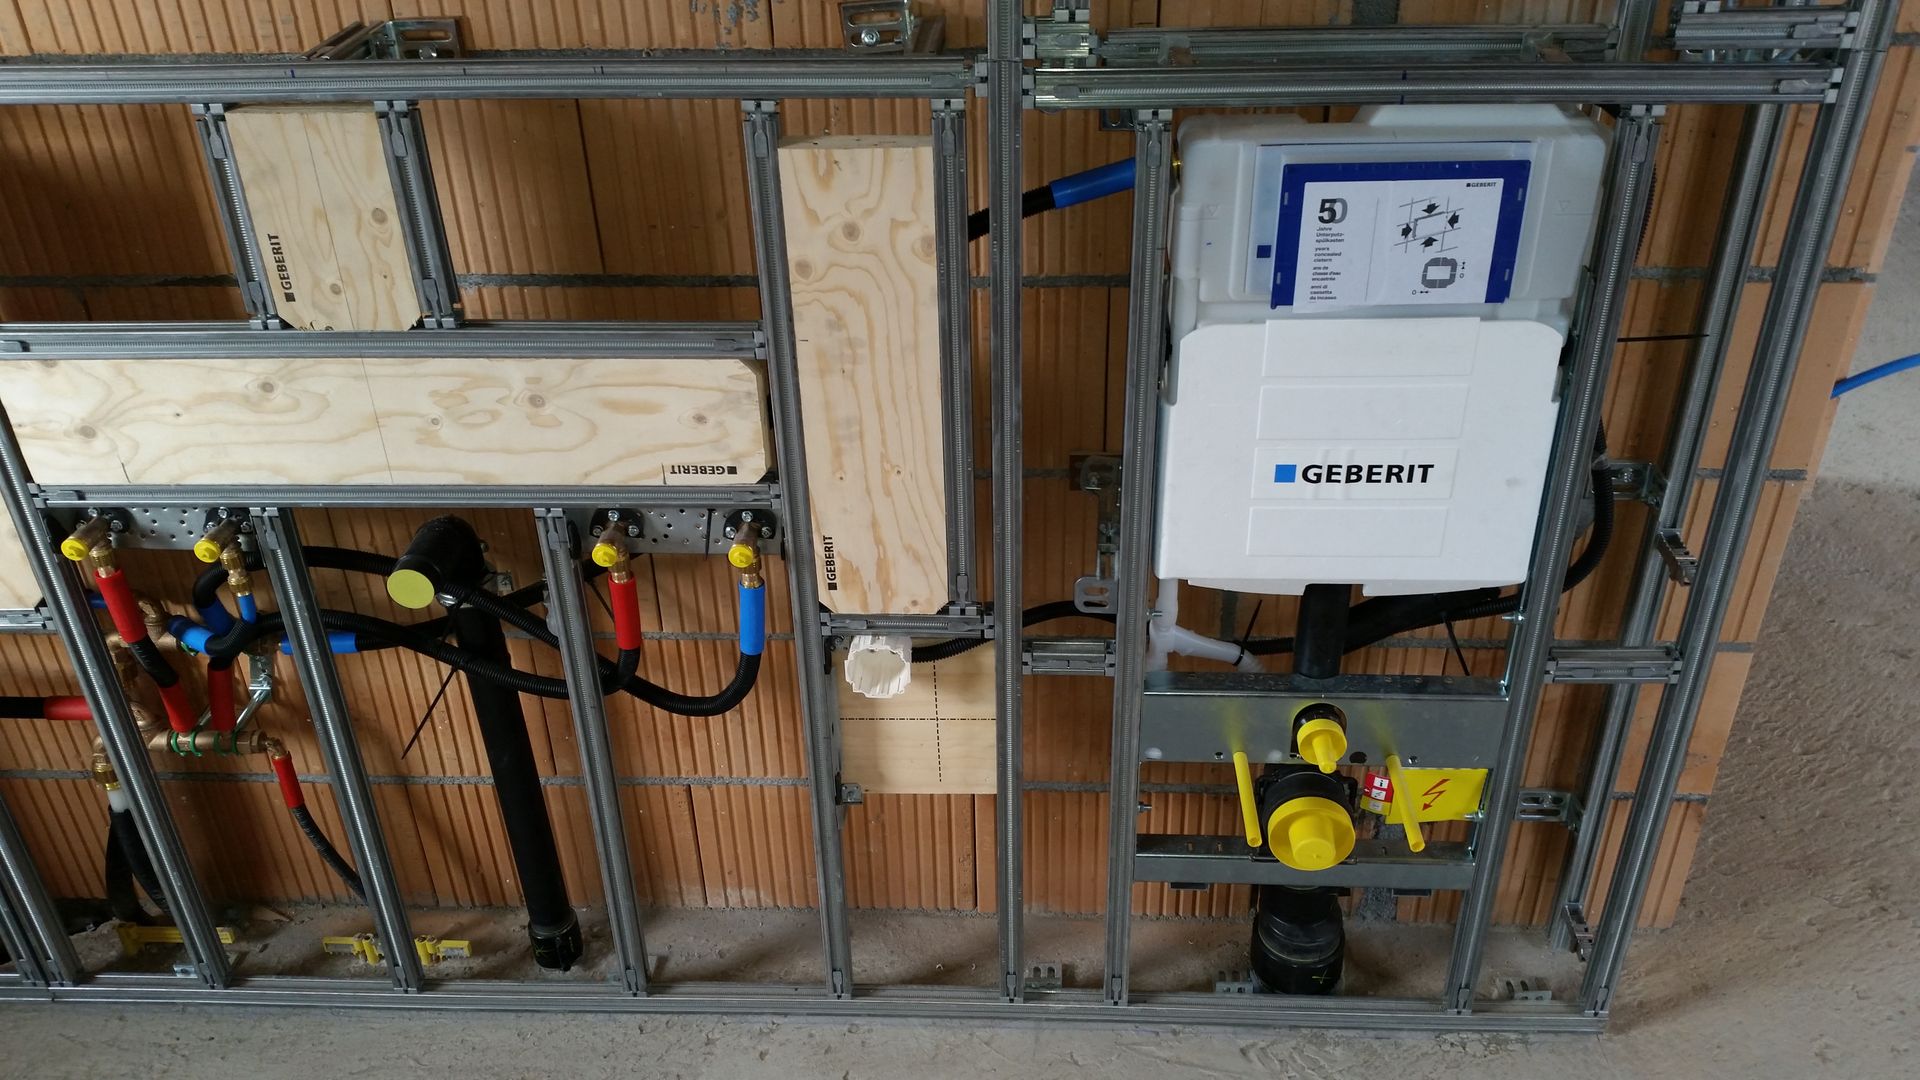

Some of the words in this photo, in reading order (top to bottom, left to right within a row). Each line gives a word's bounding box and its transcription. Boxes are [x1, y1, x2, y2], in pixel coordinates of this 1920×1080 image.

[1318, 198, 1348, 224] 50
[267, 233, 293, 290] GEBERIT
[670, 465, 726, 475] GEBERIT
[1302, 464, 1435, 484] GEBERIT
[822, 535, 837, 581] GEBERIT
